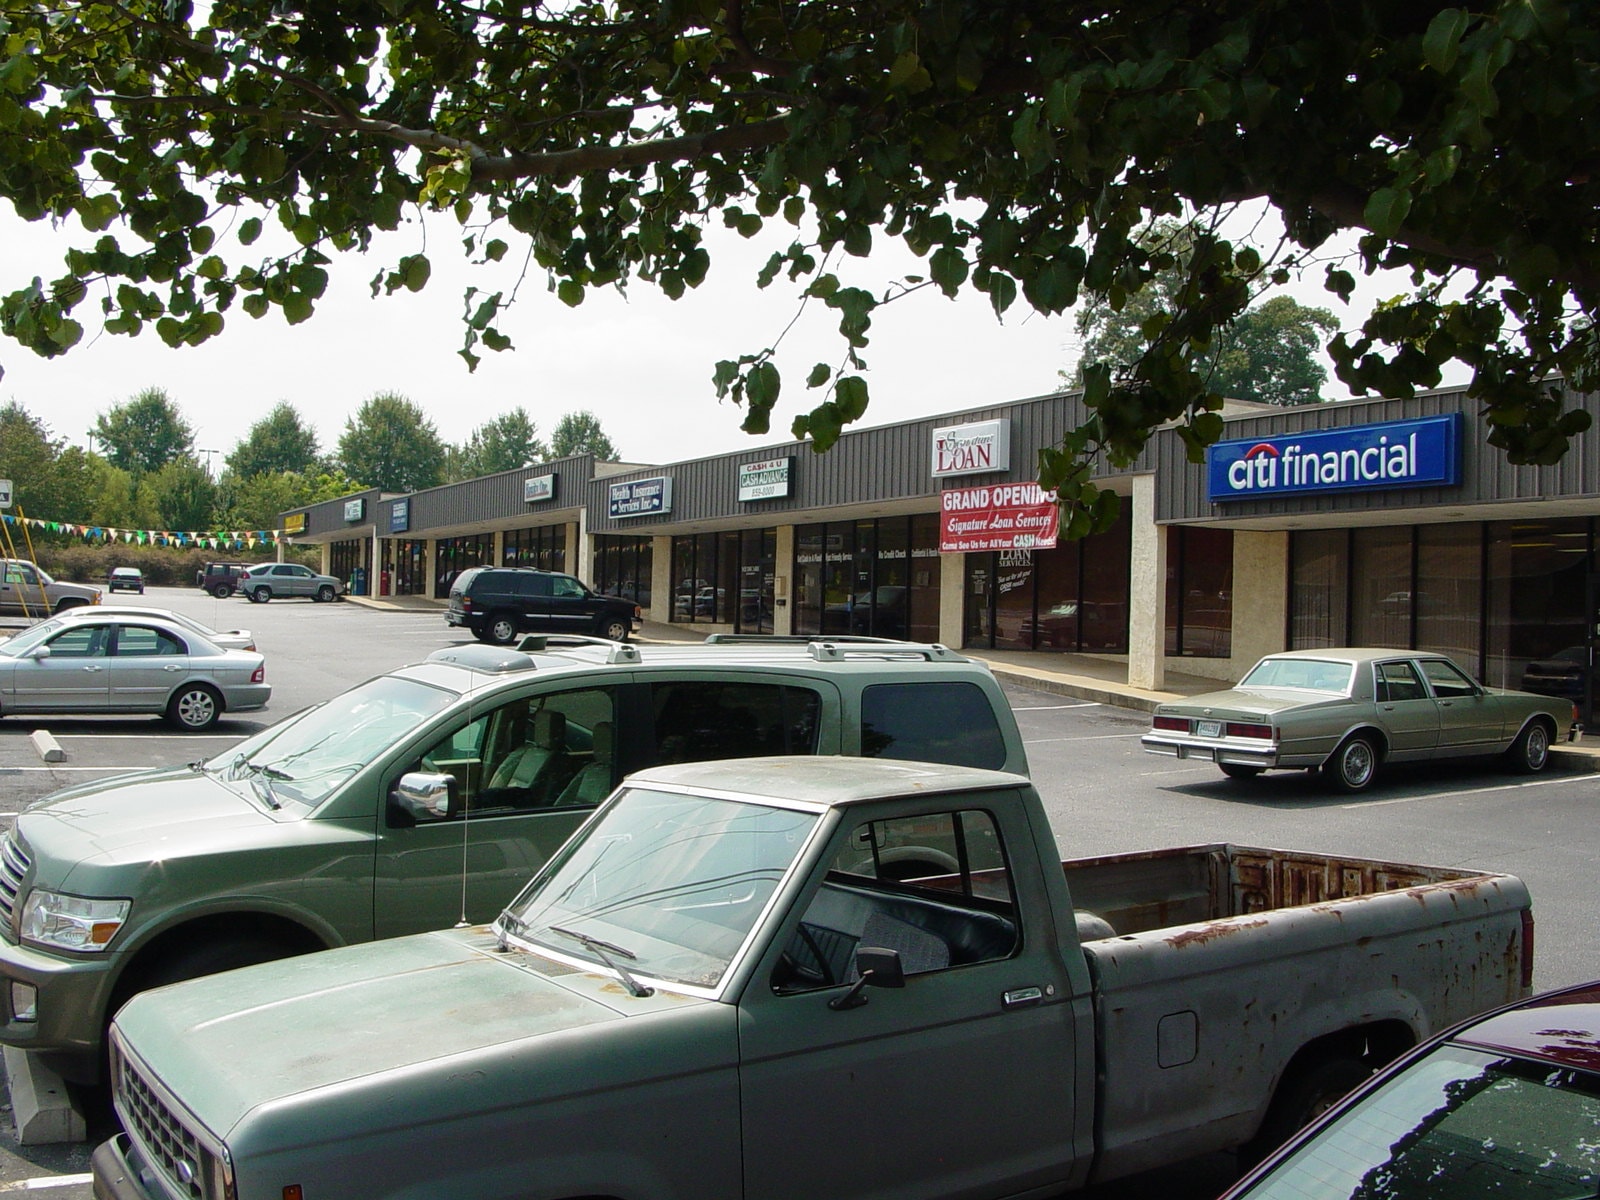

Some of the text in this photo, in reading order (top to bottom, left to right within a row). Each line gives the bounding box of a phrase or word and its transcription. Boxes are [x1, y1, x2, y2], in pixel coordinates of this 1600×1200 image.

[936, 439, 992, 472] LOAN
[741, 468, 788, 487] CASH ADVANCE
[612, 484, 660, 501] Health Insurance
[943, 489, 990, 511] GRAND
[618, 499, 640, 513] Services
[947, 511, 1052, 536] Signature Loan Services
[942, 541, 957, 550] Come
[958, 540, 969, 549] See
[970, 540, 979, 549] Us
[979, 539, 989, 548] for
[997, 538, 1012, 548] Your
